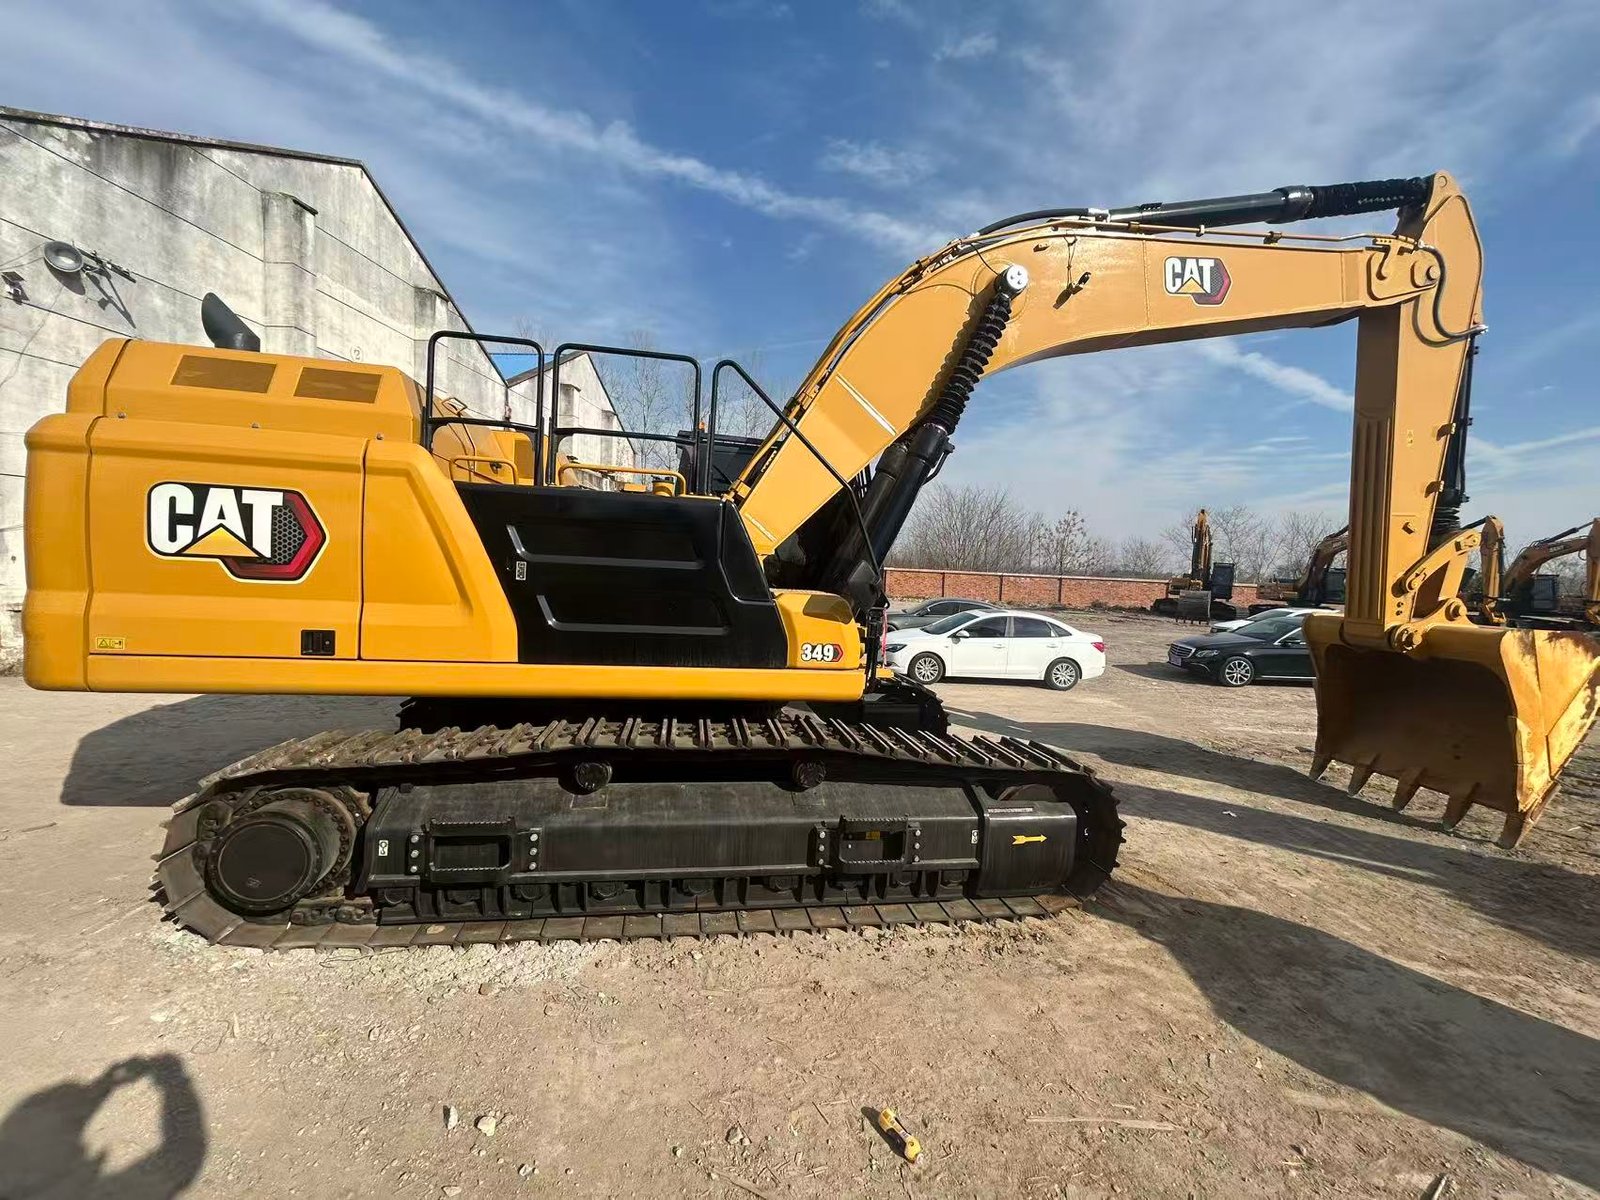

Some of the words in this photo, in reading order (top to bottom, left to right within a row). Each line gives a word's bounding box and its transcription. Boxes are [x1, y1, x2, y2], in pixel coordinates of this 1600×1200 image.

[1165, 257, 1215, 294] CAT
[150, 483, 284, 559] CAT
[801, 643, 834, 662] 349
